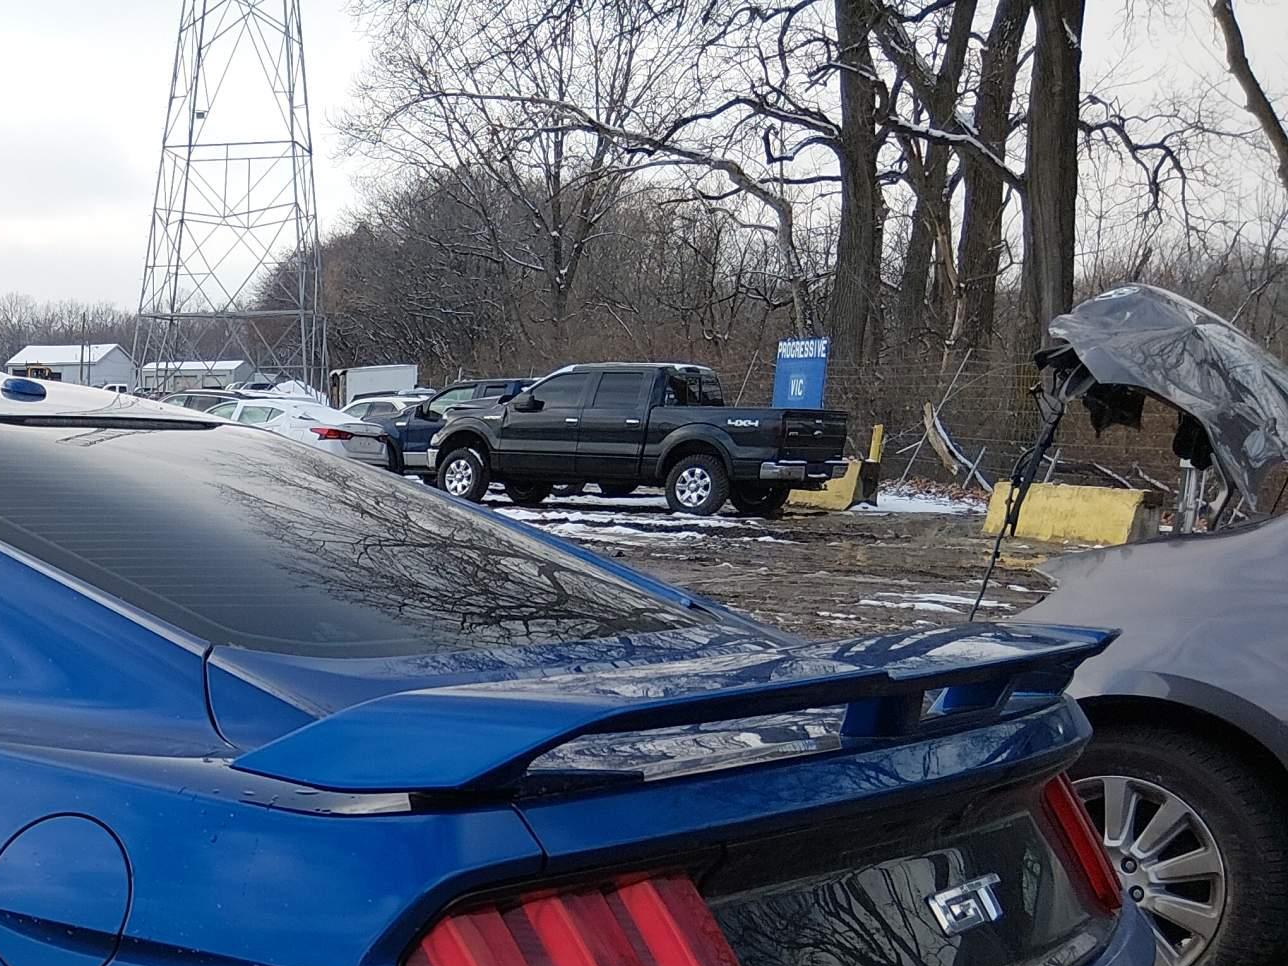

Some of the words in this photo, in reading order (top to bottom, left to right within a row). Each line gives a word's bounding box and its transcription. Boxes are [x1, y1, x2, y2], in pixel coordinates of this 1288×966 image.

[777, 340, 827, 359] PROGRESSIVE
[791, 379, 804, 396] VIC
[927, 872, 1004, 935] GT
